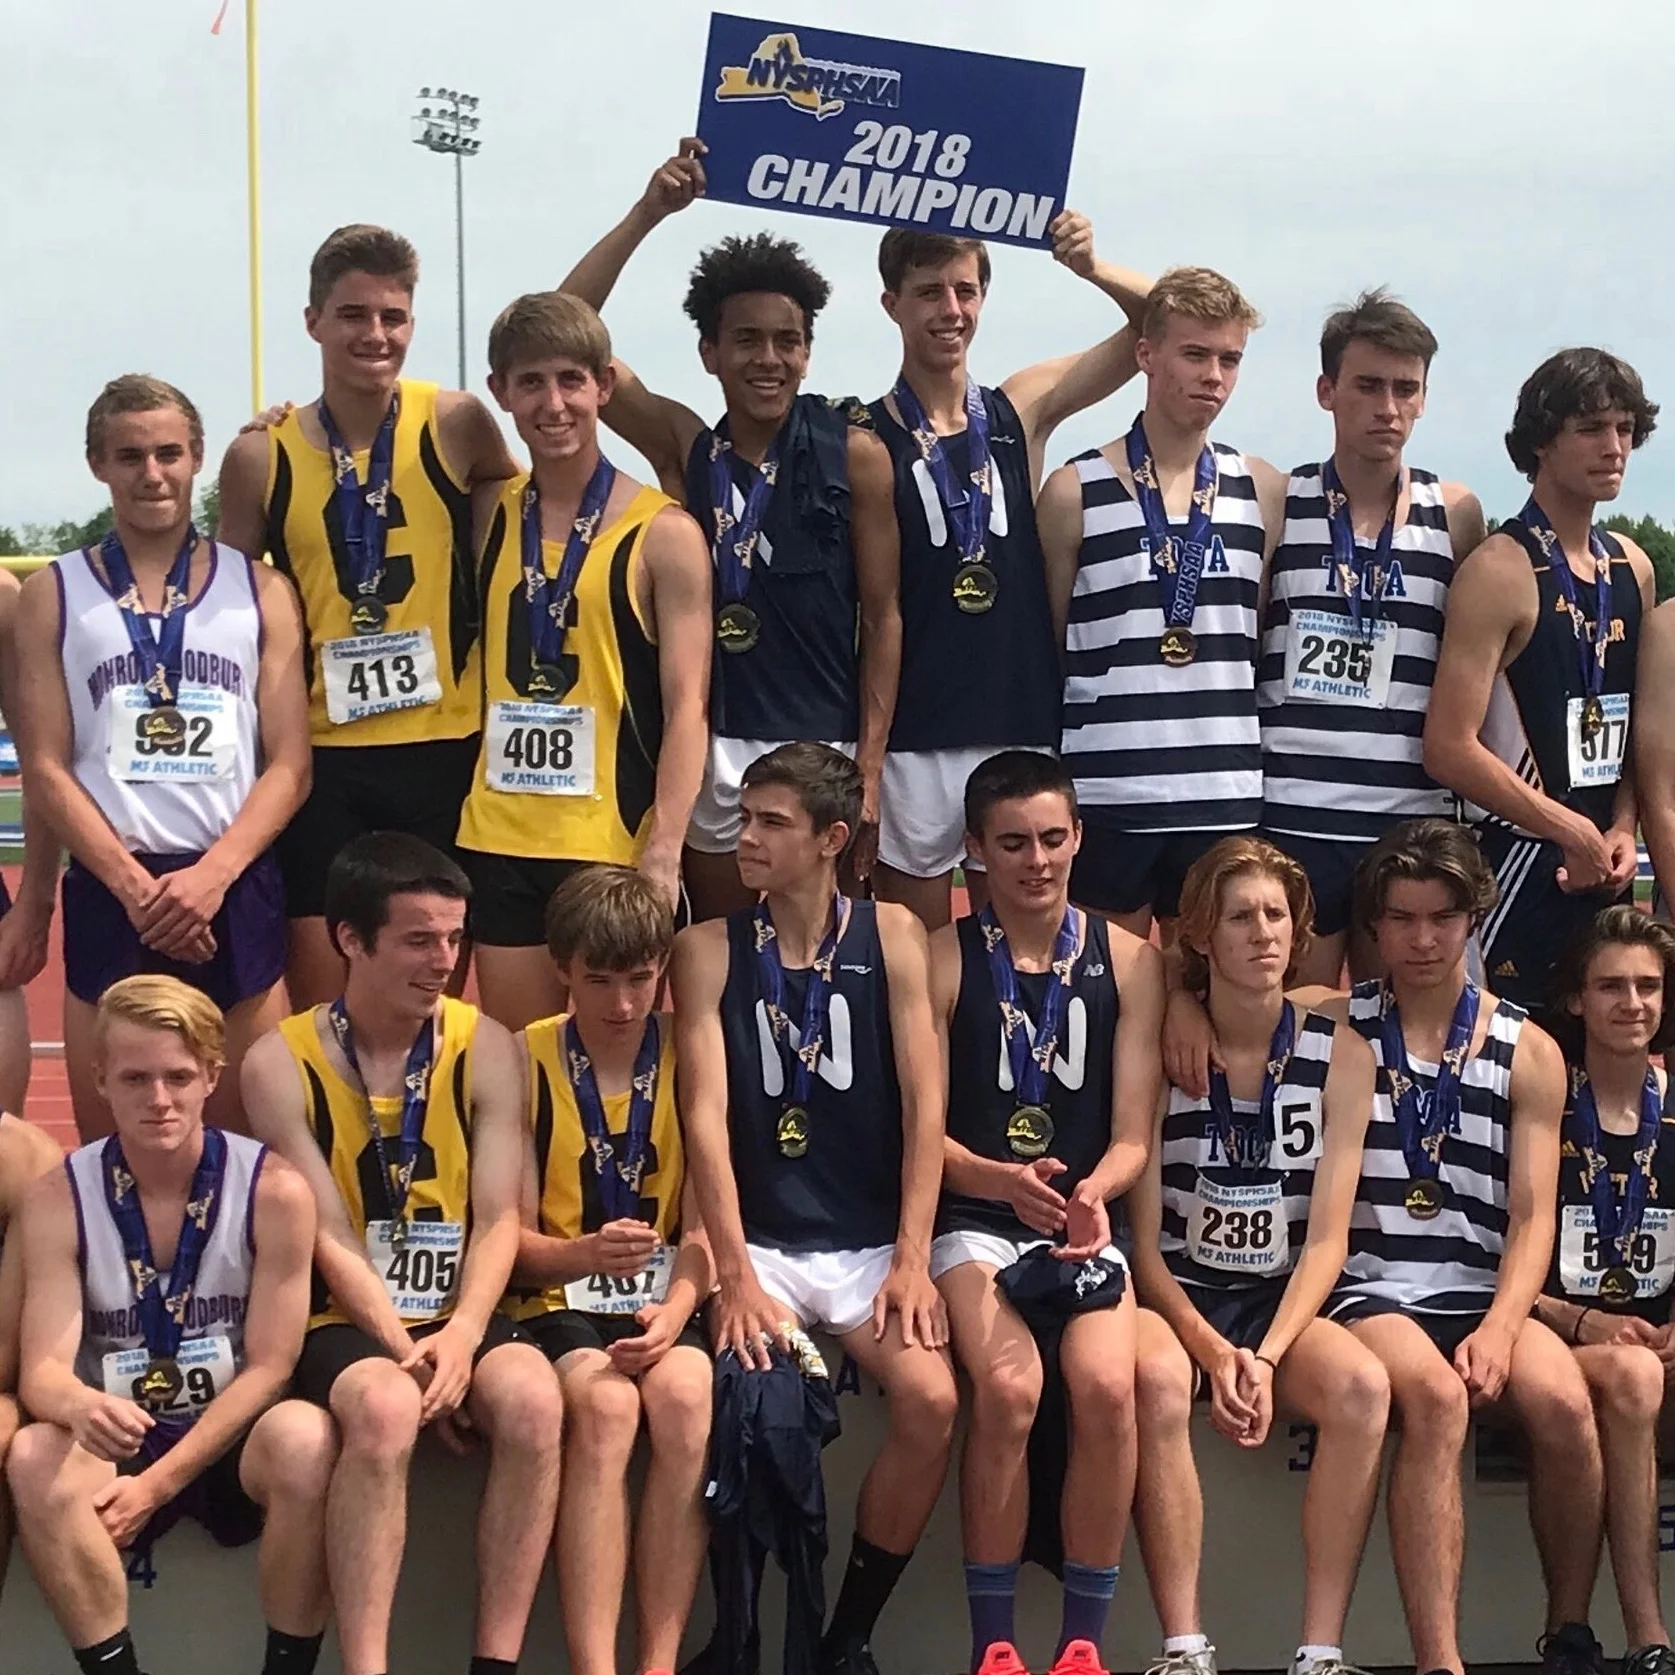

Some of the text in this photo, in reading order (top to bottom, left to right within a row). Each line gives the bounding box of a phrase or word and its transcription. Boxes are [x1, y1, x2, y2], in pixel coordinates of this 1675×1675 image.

[746, 57, 901, 108] NYSPHSAA
[844, 120, 972, 178] 2018
[746, 154, 1055, 240] CHAMPION
[1168, 540, 1205, 626] YSPHSAA
[1298, 611, 1324, 621] 2018
[347, 655, 418, 701] 413
[1298, 635, 1374, 682] 235
[367, 695, 425, 715] ATHLETIC
[1312, 680, 1372, 699] ATHLETIC
[152, 760, 217, 775] ATHLETIC
[503, 728, 573, 770] 408
[516, 773, 576, 787] ATHLETIC
[755, 993, 853, 1097] N
[1281, 1102, 1315, 1158] 5
[1198, 1188, 1282, 1208] CHAMPIONSHIPS
[1201, 1206, 1273, 1250] 238
[386, 1249, 458, 1293] 405
[1215, 1250, 1275, 1265] ATHLETIC
[1583, 1232, 1657, 1274] 59
[1288, 1424, 1317, 1471] 3
[127, 1543, 157, 1589] 4
